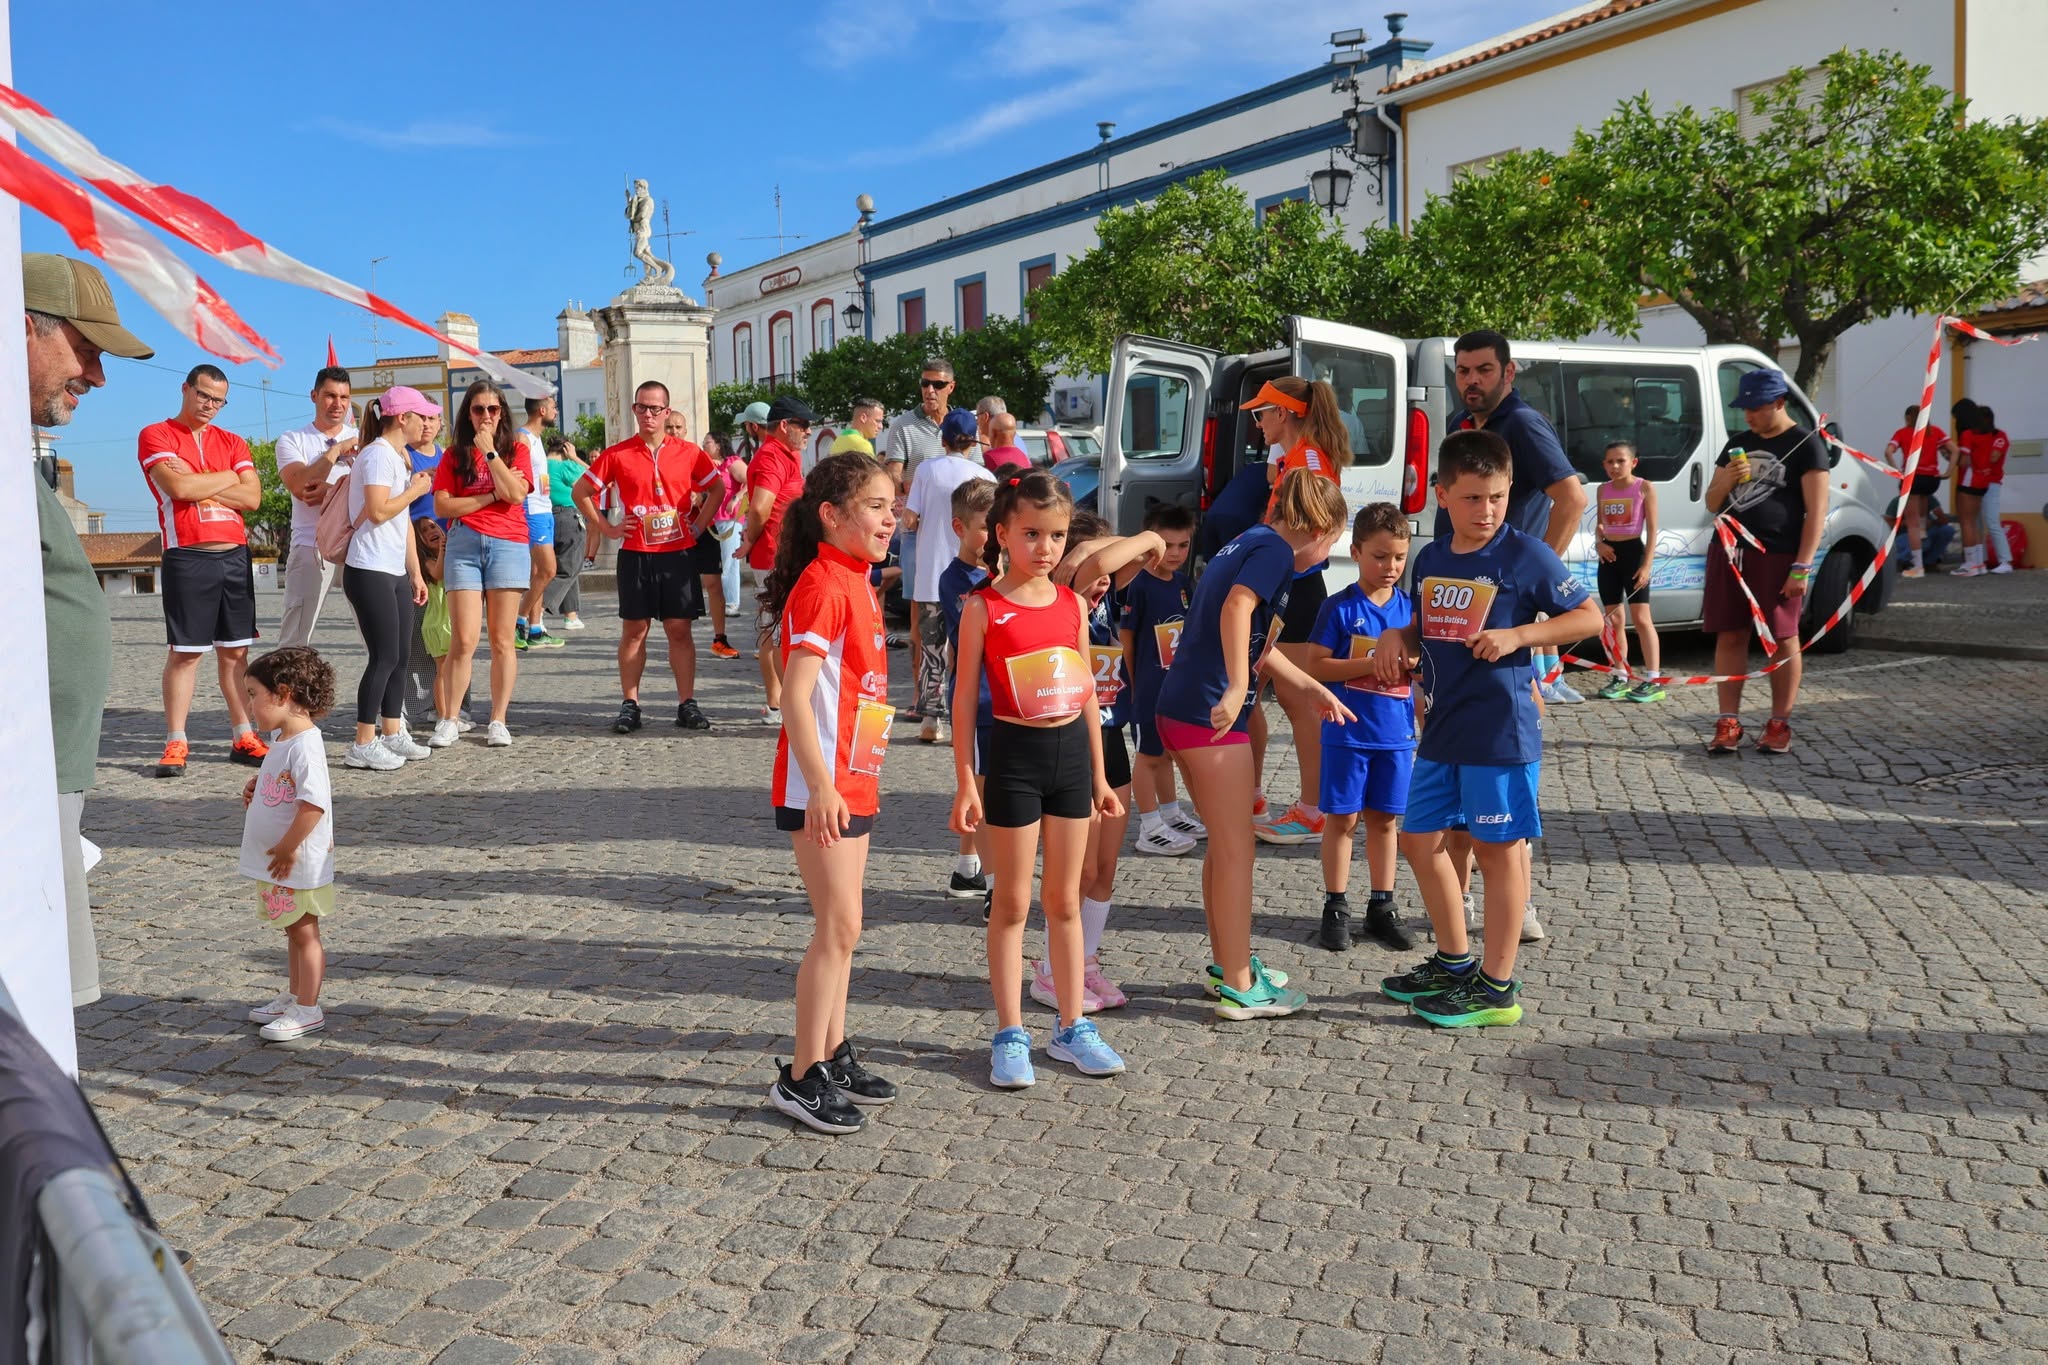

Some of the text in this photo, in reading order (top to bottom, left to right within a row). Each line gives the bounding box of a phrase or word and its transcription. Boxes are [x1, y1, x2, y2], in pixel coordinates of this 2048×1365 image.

[652, 515, 674, 530] 036
[1431, 584, 1474, 610] 300
[1427, 615, 1468, 625] Tomás Batista
[1048, 653, 1066, 679] 2
[1095, 684, 1109, 692] aria
[881, 714, 893, 740] 2
[1475, 813, 1513, 824] LEGEA
